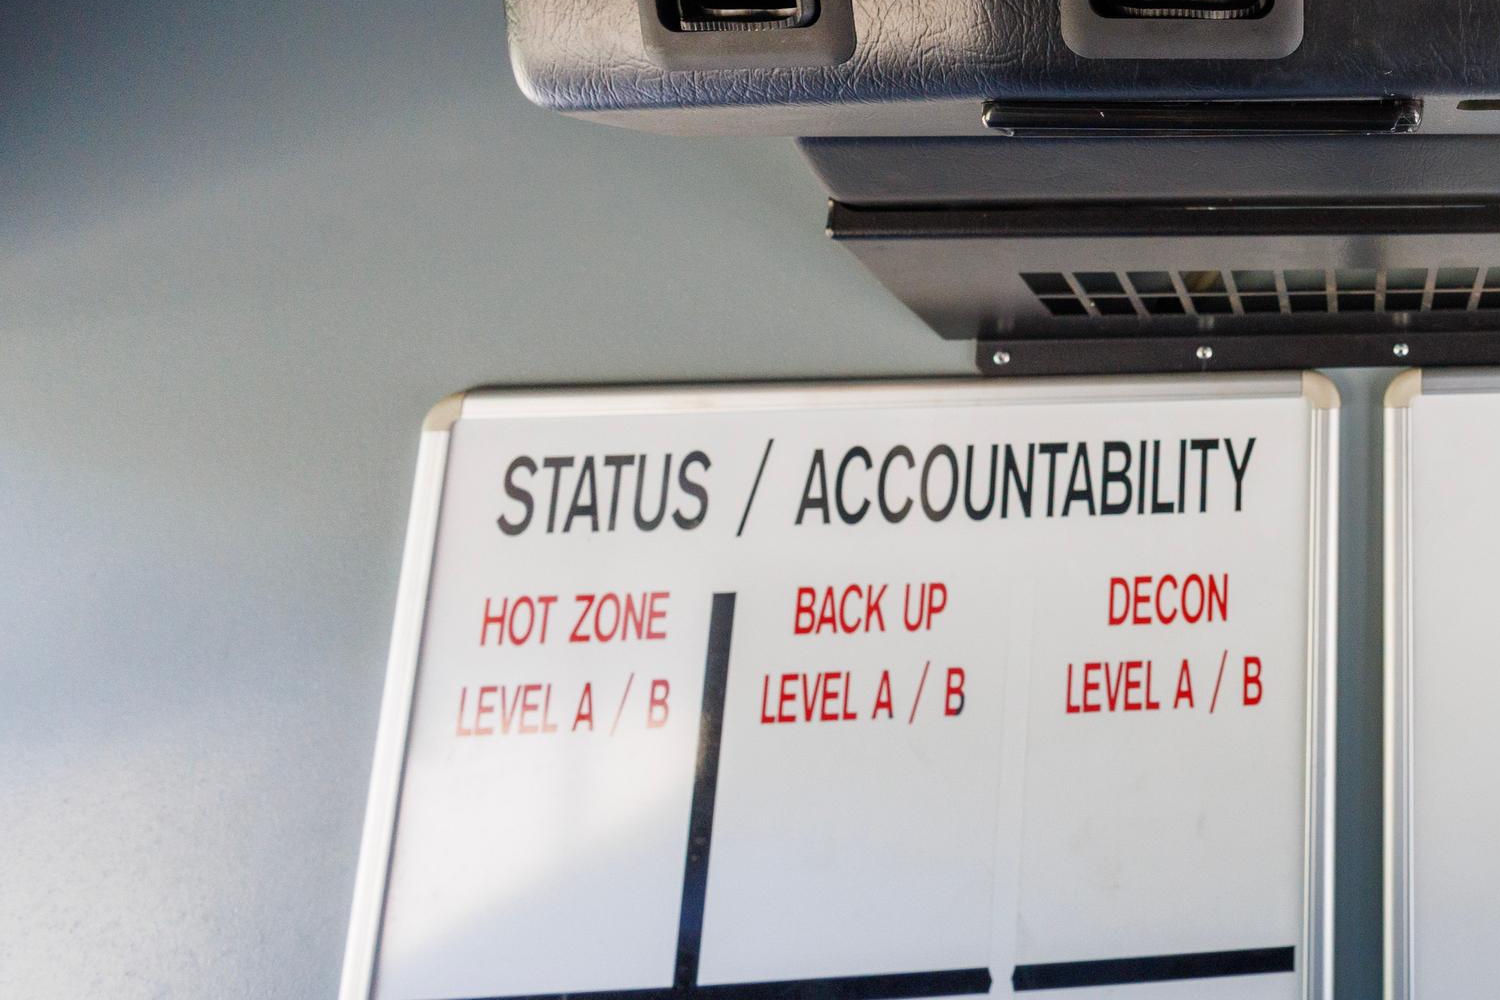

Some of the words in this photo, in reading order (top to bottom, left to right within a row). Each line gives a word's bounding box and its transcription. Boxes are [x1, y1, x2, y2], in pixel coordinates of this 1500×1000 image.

[495, 449, 713, 537] STATUS
[735, 437, 775, 538] /
[793, 436, 1258, 526] ACCOUNTABILITY
[479, 594, 560, 648] HOT
[567, 590, 673, 645] ZONE
[792, 582, 889, 637] BACK
[901, 580, 950, 634] UP
[1106, 570, 1231, 628] DECON
[455, 680, 558, 738] LEVEL
[571, 680, 594, 733] A
[609, 671, 635, 738] /
[645, 677, 672, 730] B
[759, 669, 860, 728] LEVEL
[870, 668, 895, 721] A
[907, 659, 933, 726] /
[942, 665, 968, 719] B
[1064, 658, 1163, 717] LEVEL
[1172, 656, 1197, 711] A
[1207, 648, 1231, 714] /
[1240, 654, 1266, 708] B
